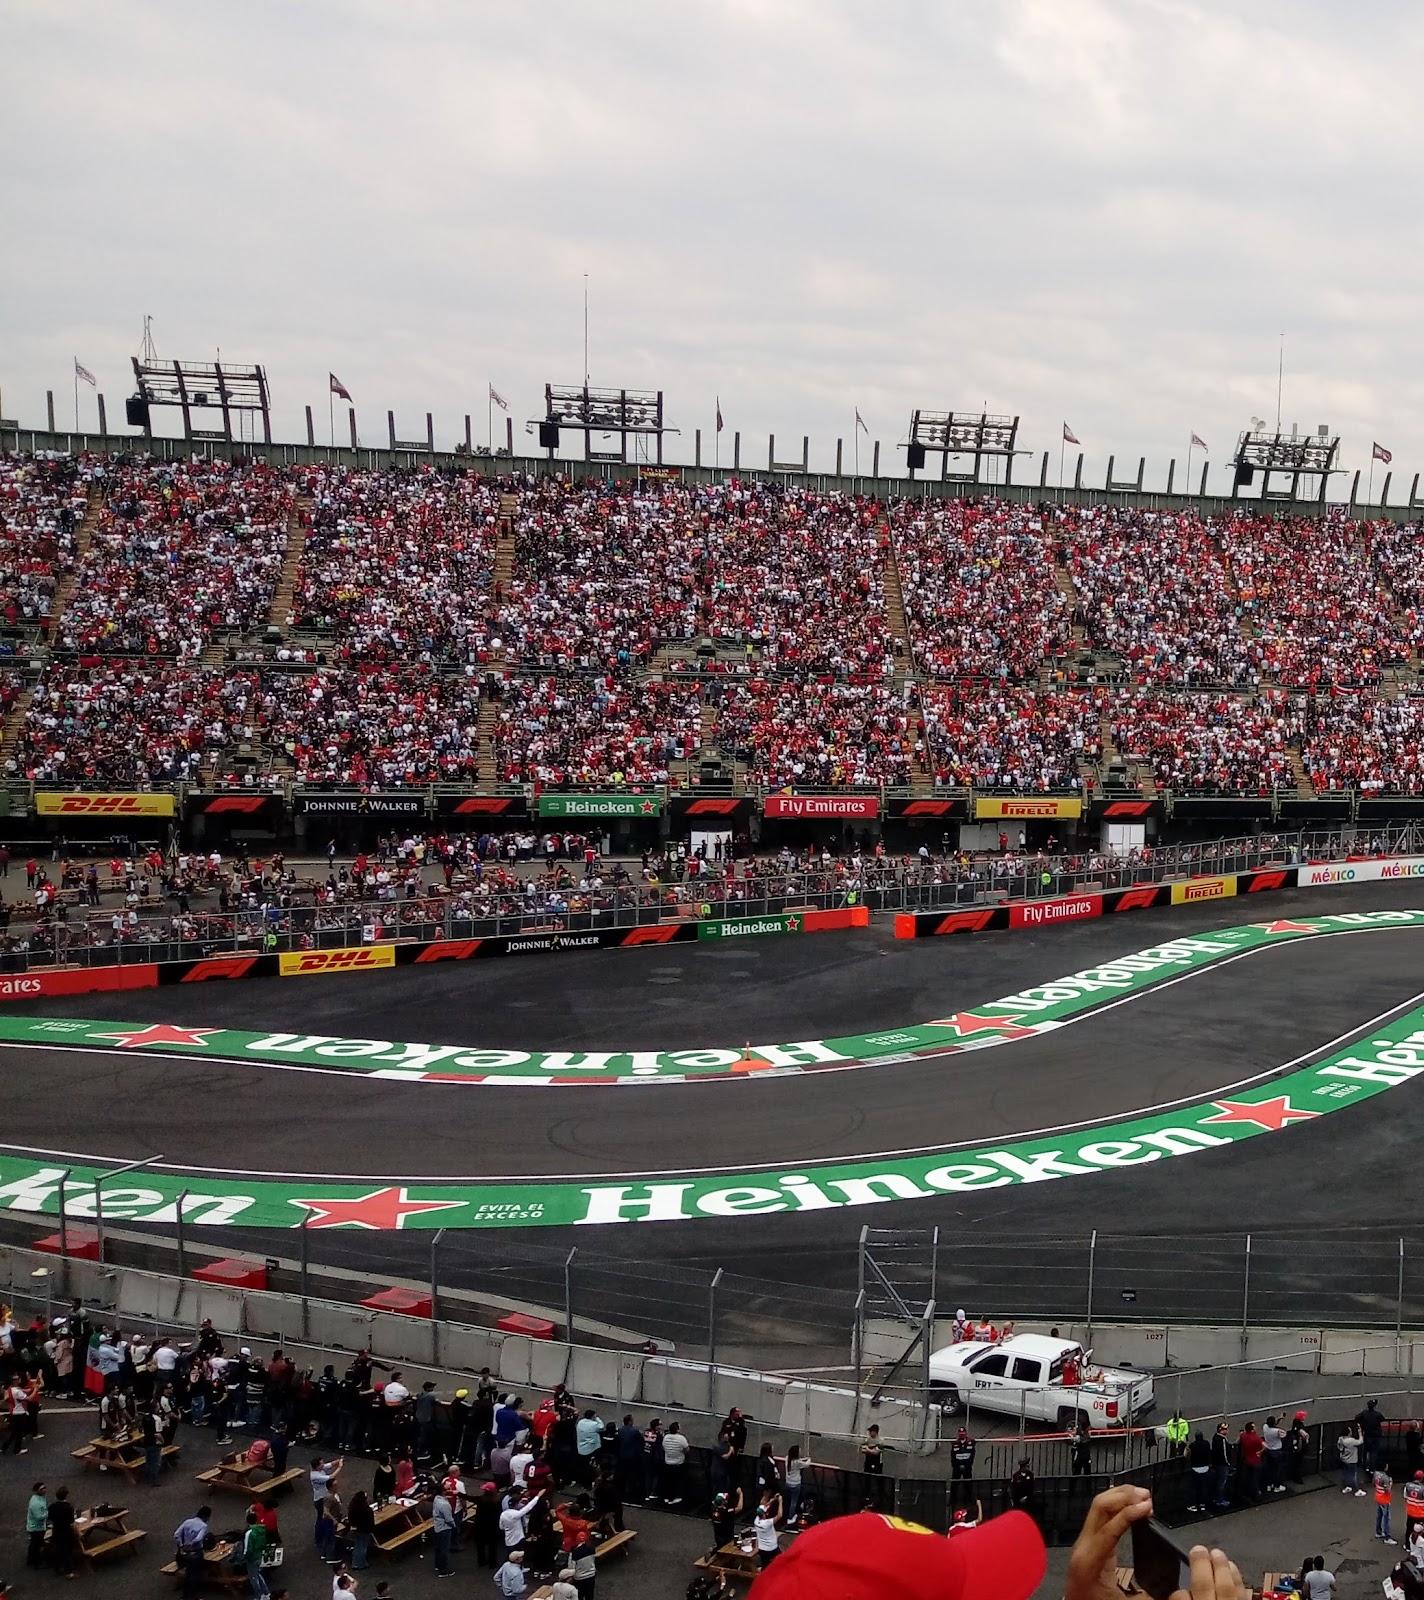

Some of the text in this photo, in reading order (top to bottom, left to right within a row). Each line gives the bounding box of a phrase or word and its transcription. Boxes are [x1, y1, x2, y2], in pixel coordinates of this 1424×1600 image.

[60, 797, 141, 812] DHL
[303, 801, 418, 812] JOHNNIE WALKER
[565, 801, 635, 813] Heineken
[779, 800, 865, 814] Fly Emirates
[1002, 802, 1059, 815] PIRELLI
[1185, 881, 1223, 899] PIRELLI
[1023, 901, 1091, 923] Fly Emirates
[721, 921, 782, 936] Heineken
[506, 937, 600, 952] JOHNNIE WALKER
[299, 951, 376, 970] DHL
[979, 937, 1239, 1011] Heineken
[246, 1033, 843, 1077] Heineken
[577, 1125, 1234, 1226] Heineken
[479, 1203, 544, 1212] EVITA EL
[474, 1211, 543, 1220] EXCESO
[1093, 1400, 1104, 1411] 09
[528, 1465, 536, 1478] 8
